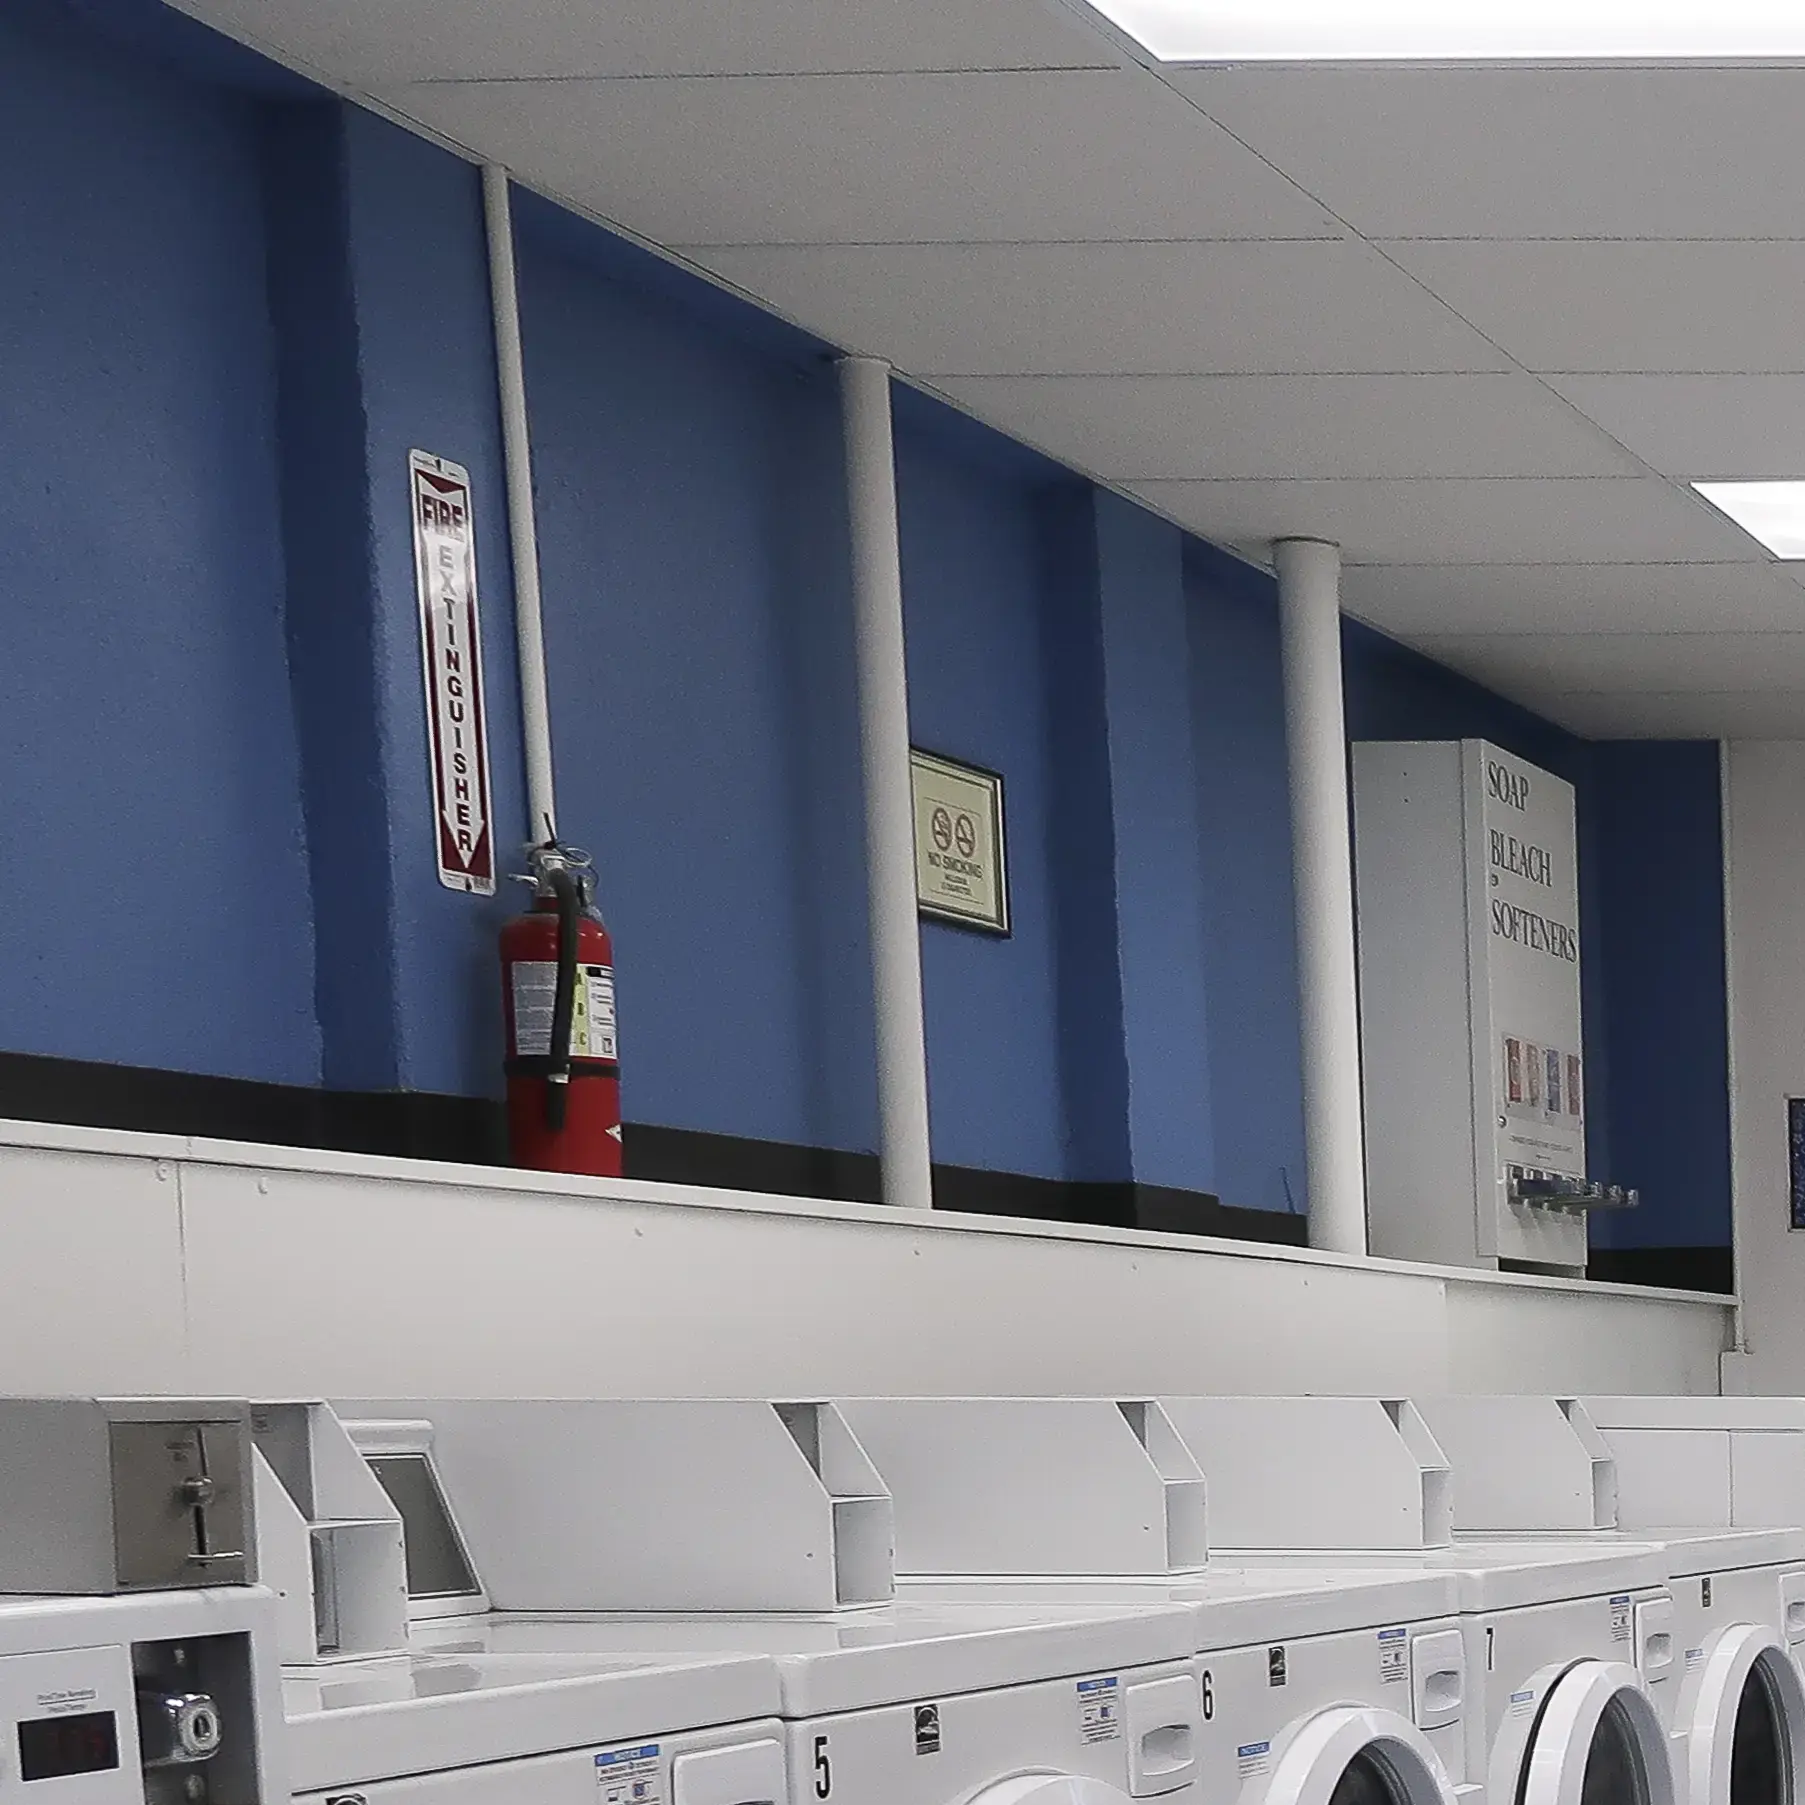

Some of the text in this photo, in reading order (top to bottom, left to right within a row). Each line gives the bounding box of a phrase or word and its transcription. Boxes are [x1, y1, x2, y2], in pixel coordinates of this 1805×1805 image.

[422, 494, 464, 542] FIRE
[437, 546, 473, 851] EXTINGUISHER
[1488, 761, 1529, 812] SOAP
[1490, 829, 1552, 887] BLEACH
[1492, 899, 1577, 963] SOFTENERS
[1202, 1669, 1214, 1720] 6
[815, 1736, 830, 1799] 5
